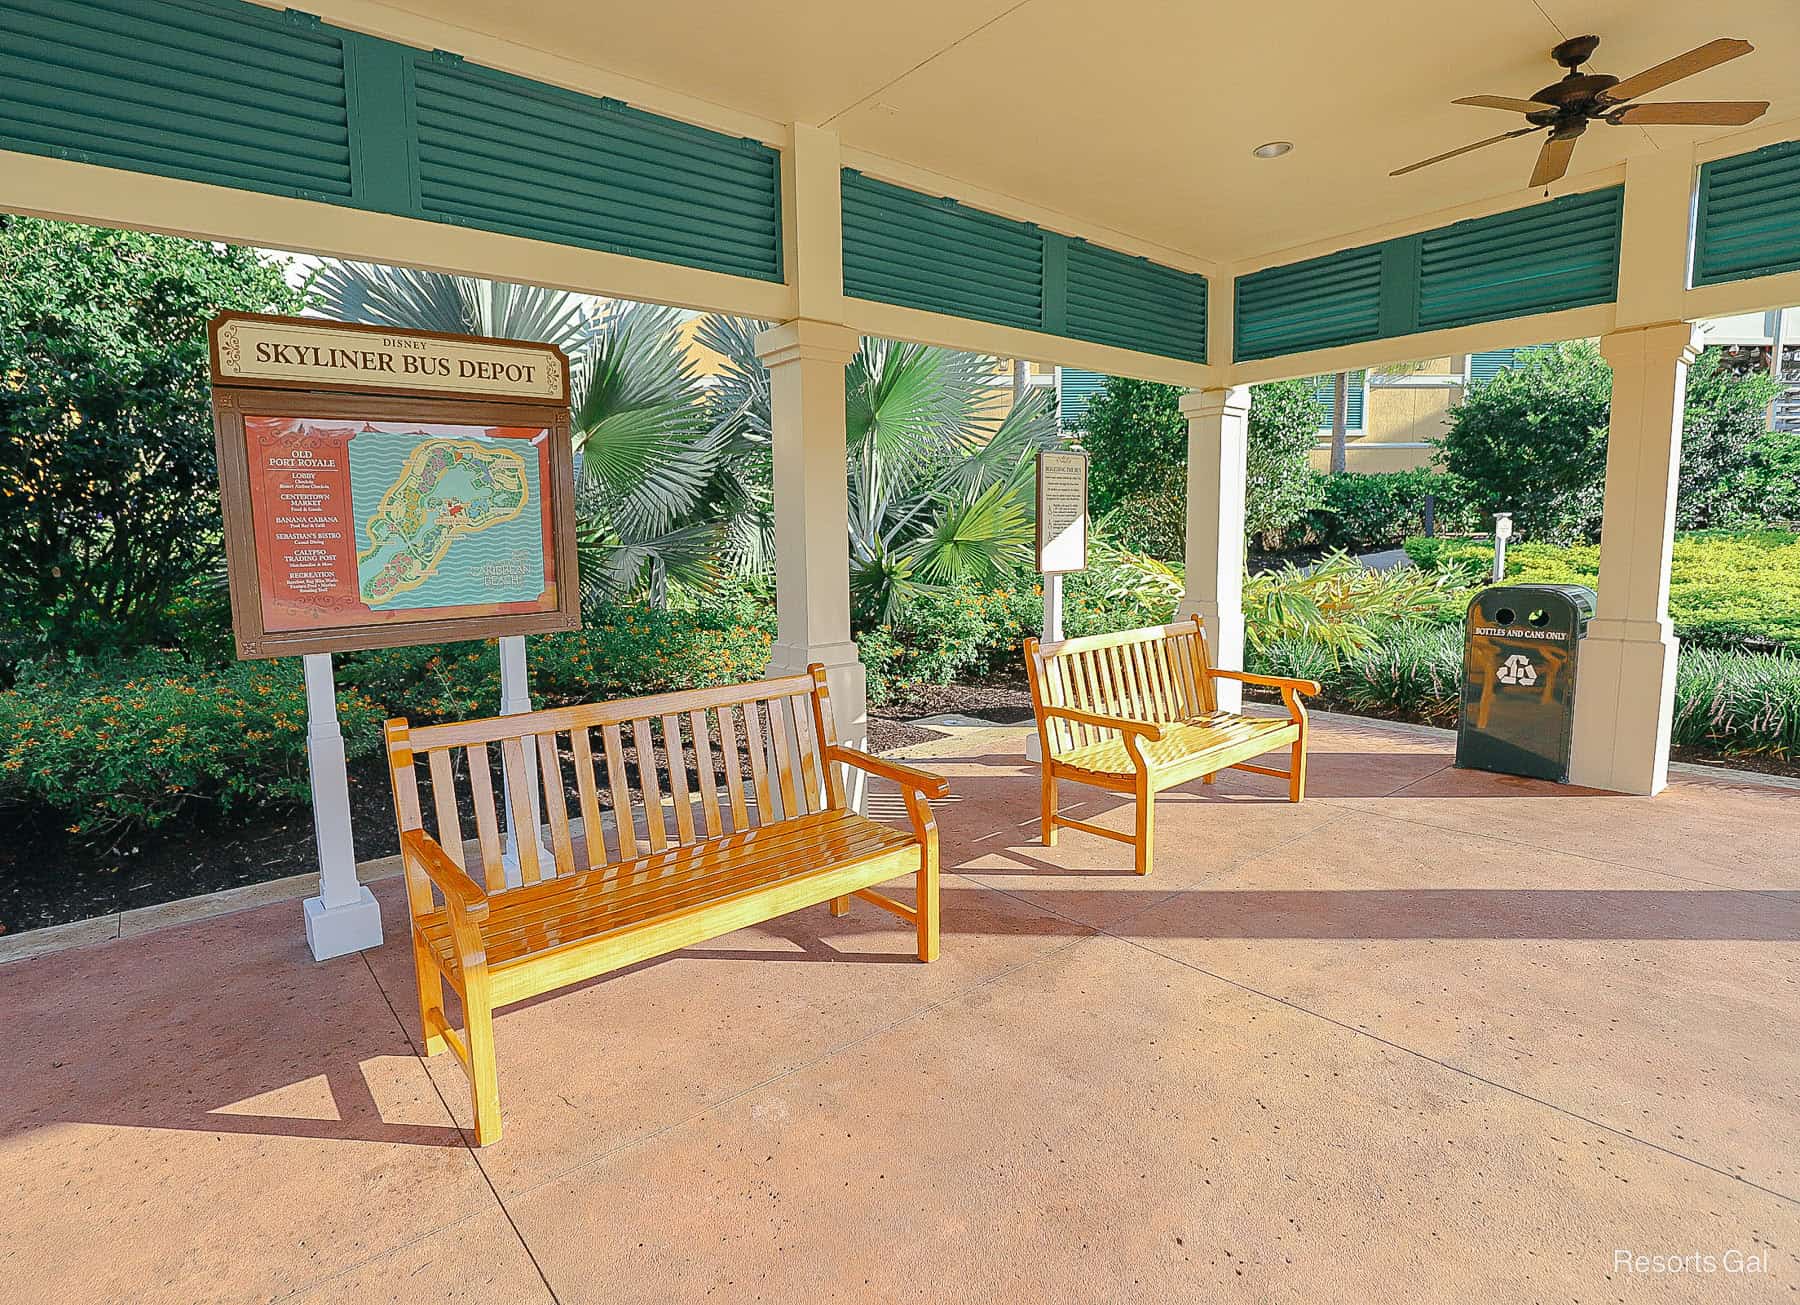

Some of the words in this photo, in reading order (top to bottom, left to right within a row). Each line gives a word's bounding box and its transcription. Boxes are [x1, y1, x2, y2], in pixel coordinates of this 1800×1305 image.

[383, 338, 427, 350] DISNEY
[256, 342, 396, 373] SKYLINER
[402, 355, 450, 376] BUS
[458, 360, 535, 383] DEPOT
[291, 450, 312, 459] OLD
[269, 458, 295, 466] PORT
[298, 459, 336, 467] ROYALE
[1475, 627, 1506, 637] BOTTLES
[1506, 629, 1523, 638] AND
[1524, 630, 1545, 639] CANS
[1546, 631, 1567, 640] ONLY
